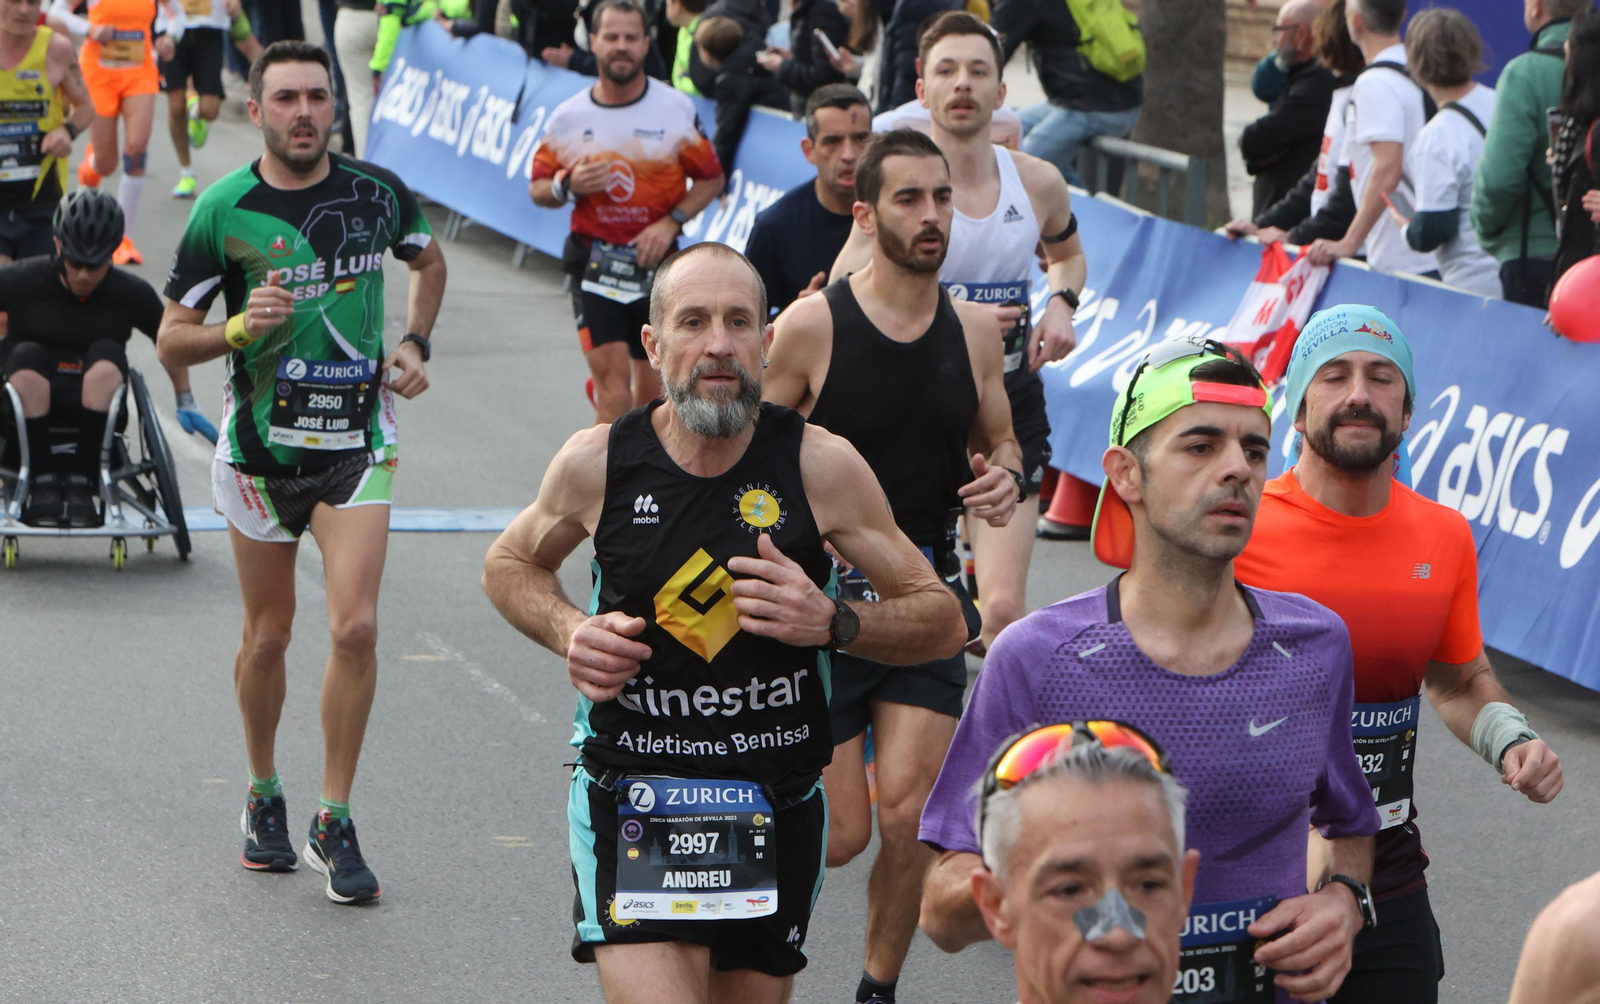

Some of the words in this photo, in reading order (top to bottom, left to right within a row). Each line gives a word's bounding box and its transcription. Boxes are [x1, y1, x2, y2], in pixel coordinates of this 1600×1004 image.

[334, 252, 382, 277] LUIS
[293, 282, 329, 299] ESP
[974, 286, 1022, 301] ZURICH
[1302, 326, 1349, 361] SEVILLA
[313, 364, 363, 379] ZURICH
[307, 393, 343, 410] 2950
[293, 415, 325, 430] JOSÉ
[1437, 404, 1570, 540] asics
[733, 482, 783, 502] BENISSA
[633, 515, 660, 525] mobel
[732, 507, 788, 535] ATLETISME
[617, 668, 808, 717] Ginestar
[1351, 705, 1412, 728] ZURICH
[616, 731, 728, 756] Atletisme
[730, 723, 810, 754] Benissa
[665, 787, 754, 806] ZURICH
[666, 815, 694, 823] MARATÓN
[668, 832, 720, 855] 2997
[661, 869, 732, 889] ANDREU
[632, 901, 655, 909] asics
[1178, 908, 1256, 937] URICH
